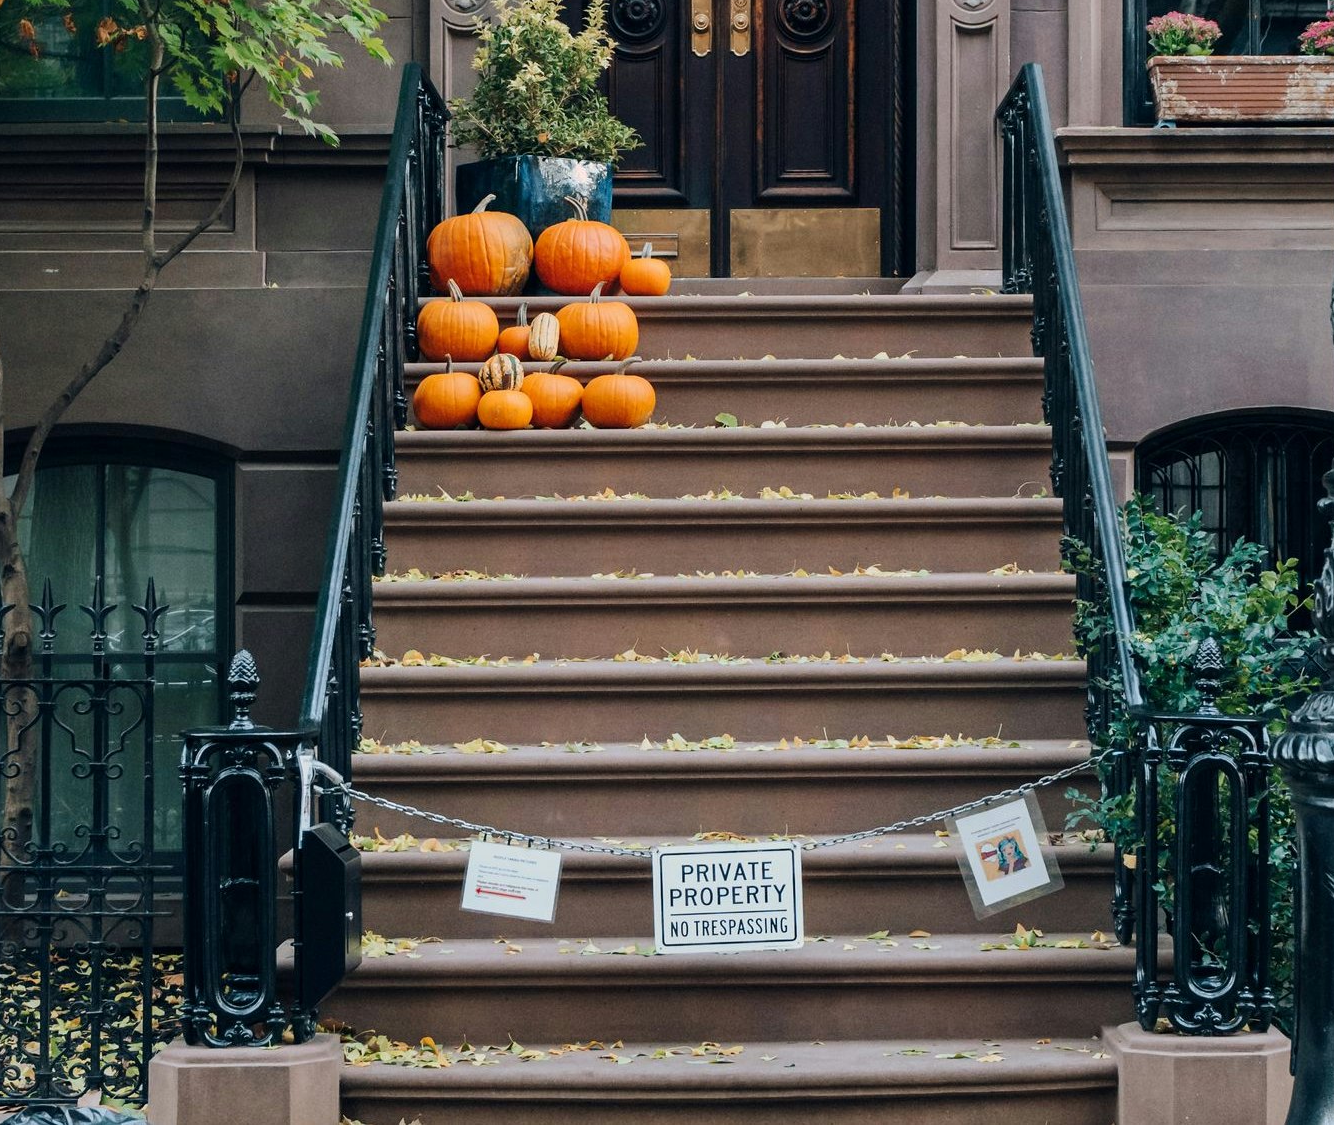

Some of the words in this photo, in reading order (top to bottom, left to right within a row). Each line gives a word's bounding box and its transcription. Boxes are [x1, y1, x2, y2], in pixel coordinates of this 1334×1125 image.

[681, 861, 774, 883] PRIVATE
[669, 884, 786, 907] PROPERTY
[670, 921, 689, 938] NO
[694, 916, 788, 937] TRESPASSING
